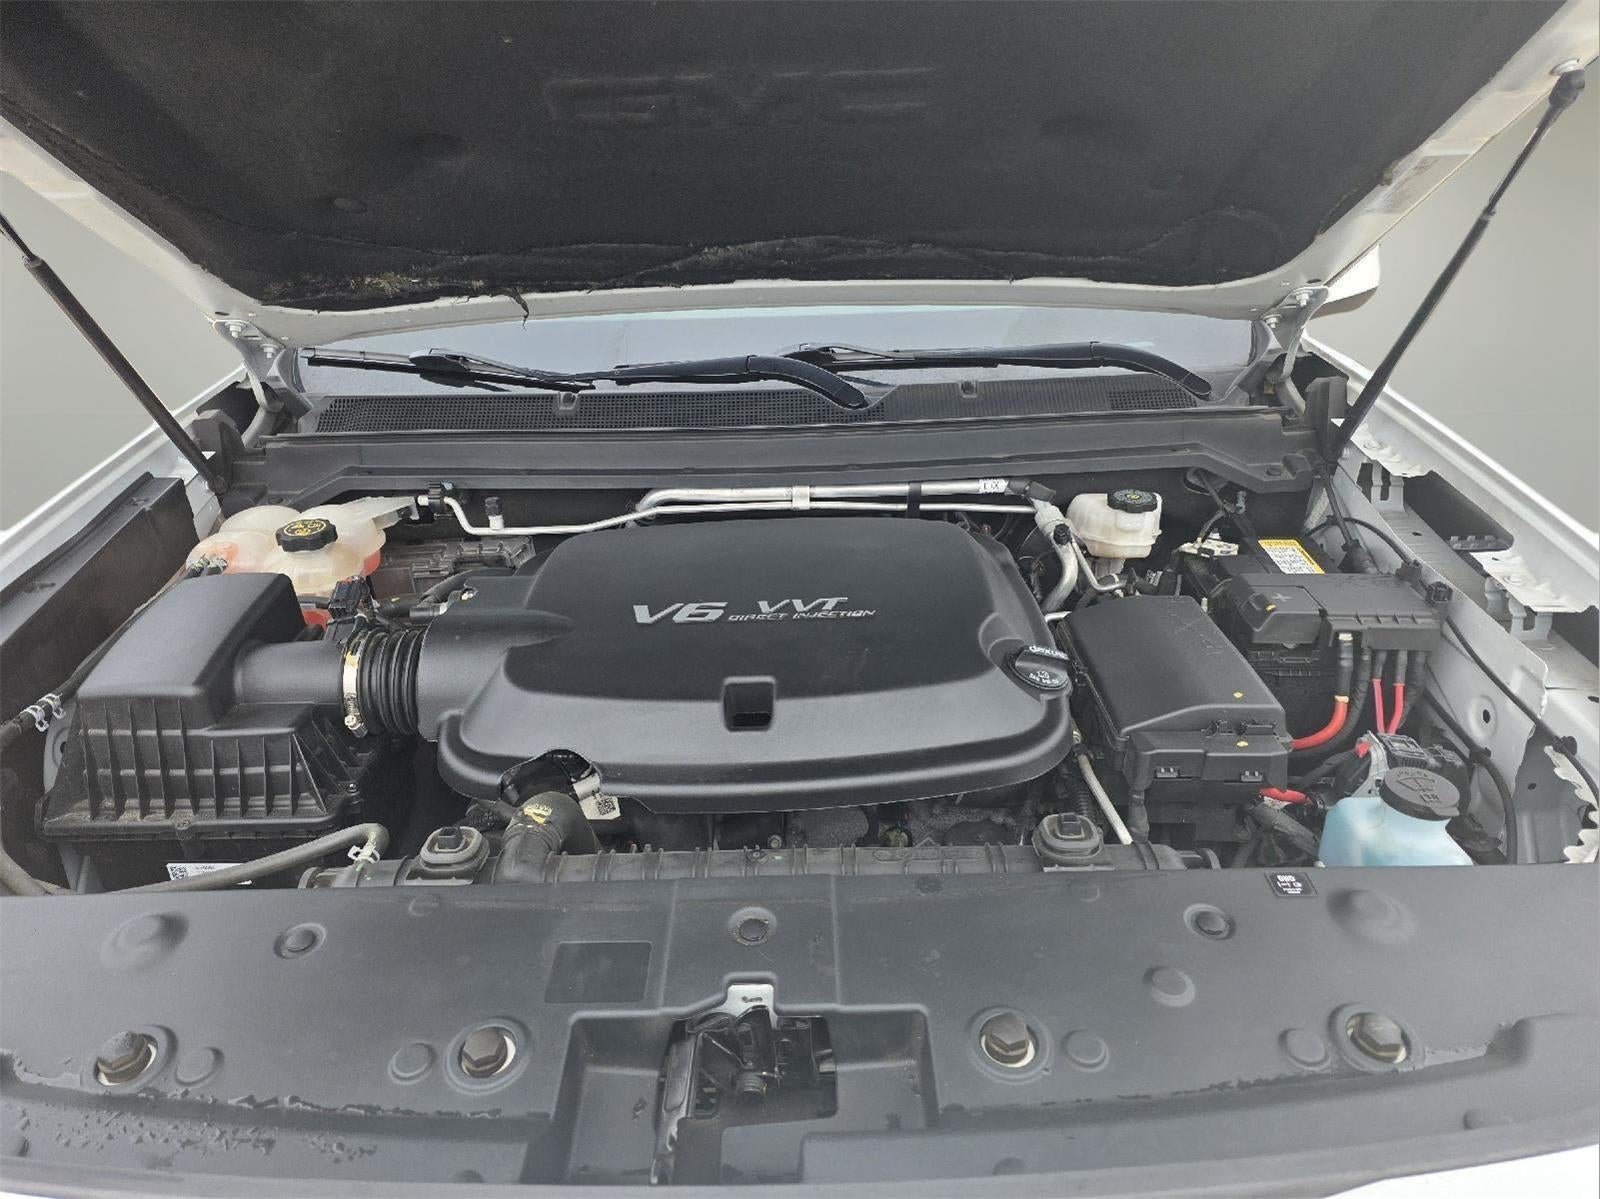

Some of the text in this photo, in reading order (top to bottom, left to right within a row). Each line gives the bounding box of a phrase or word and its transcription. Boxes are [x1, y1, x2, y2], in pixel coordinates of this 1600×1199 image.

[632, 596, 849, 624] V6 VVT
[727, 609, 877, 622] DIRECT INJECTION
